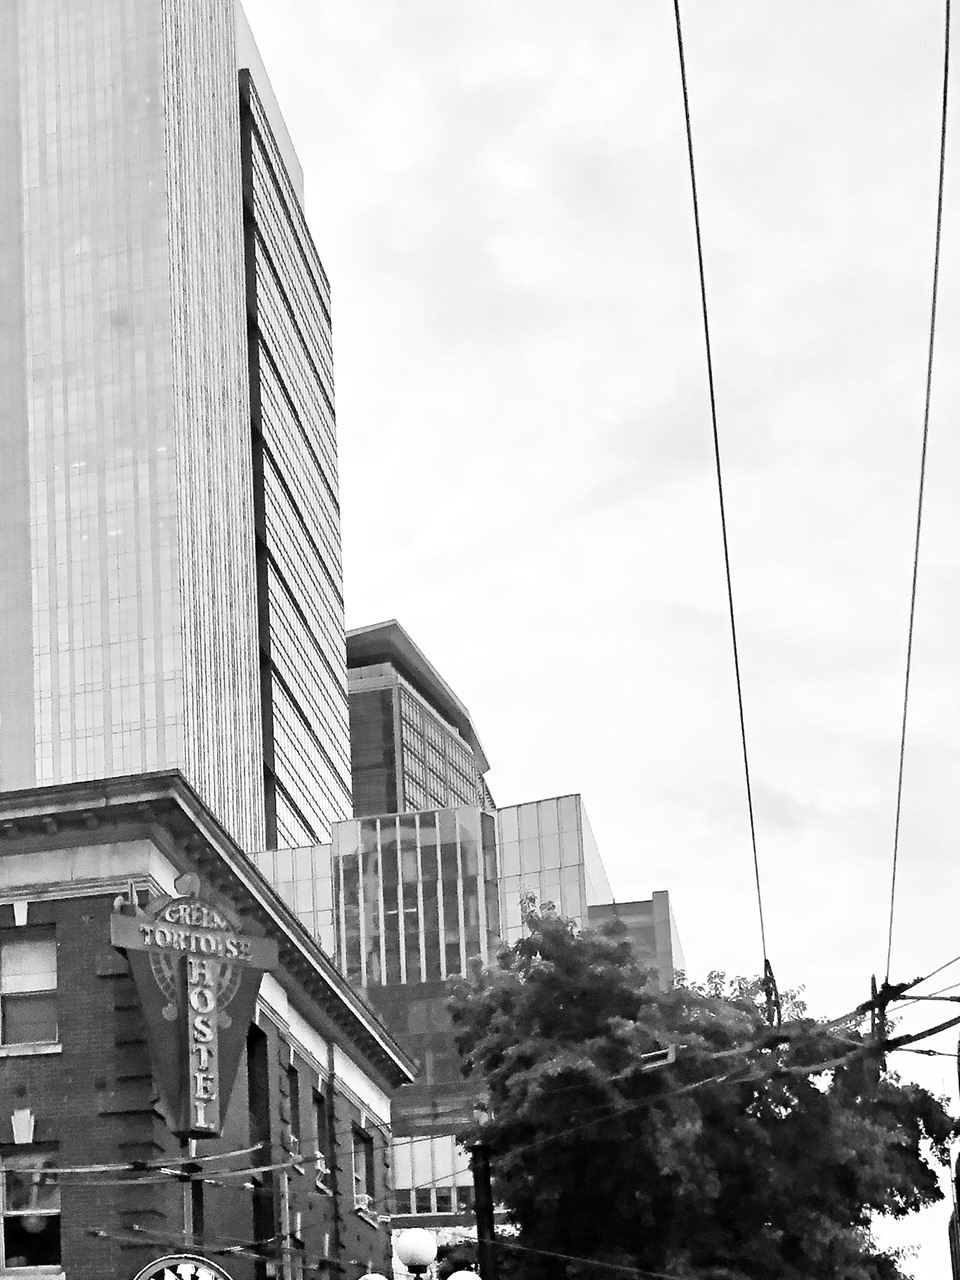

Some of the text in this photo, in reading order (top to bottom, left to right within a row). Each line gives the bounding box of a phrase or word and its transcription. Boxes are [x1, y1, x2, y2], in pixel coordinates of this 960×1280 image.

[165, 904, 228, 930] GREEN
[140, 923, 253, 961] TORTOISE
[189, 958, 217, 1129] HOSTEL
